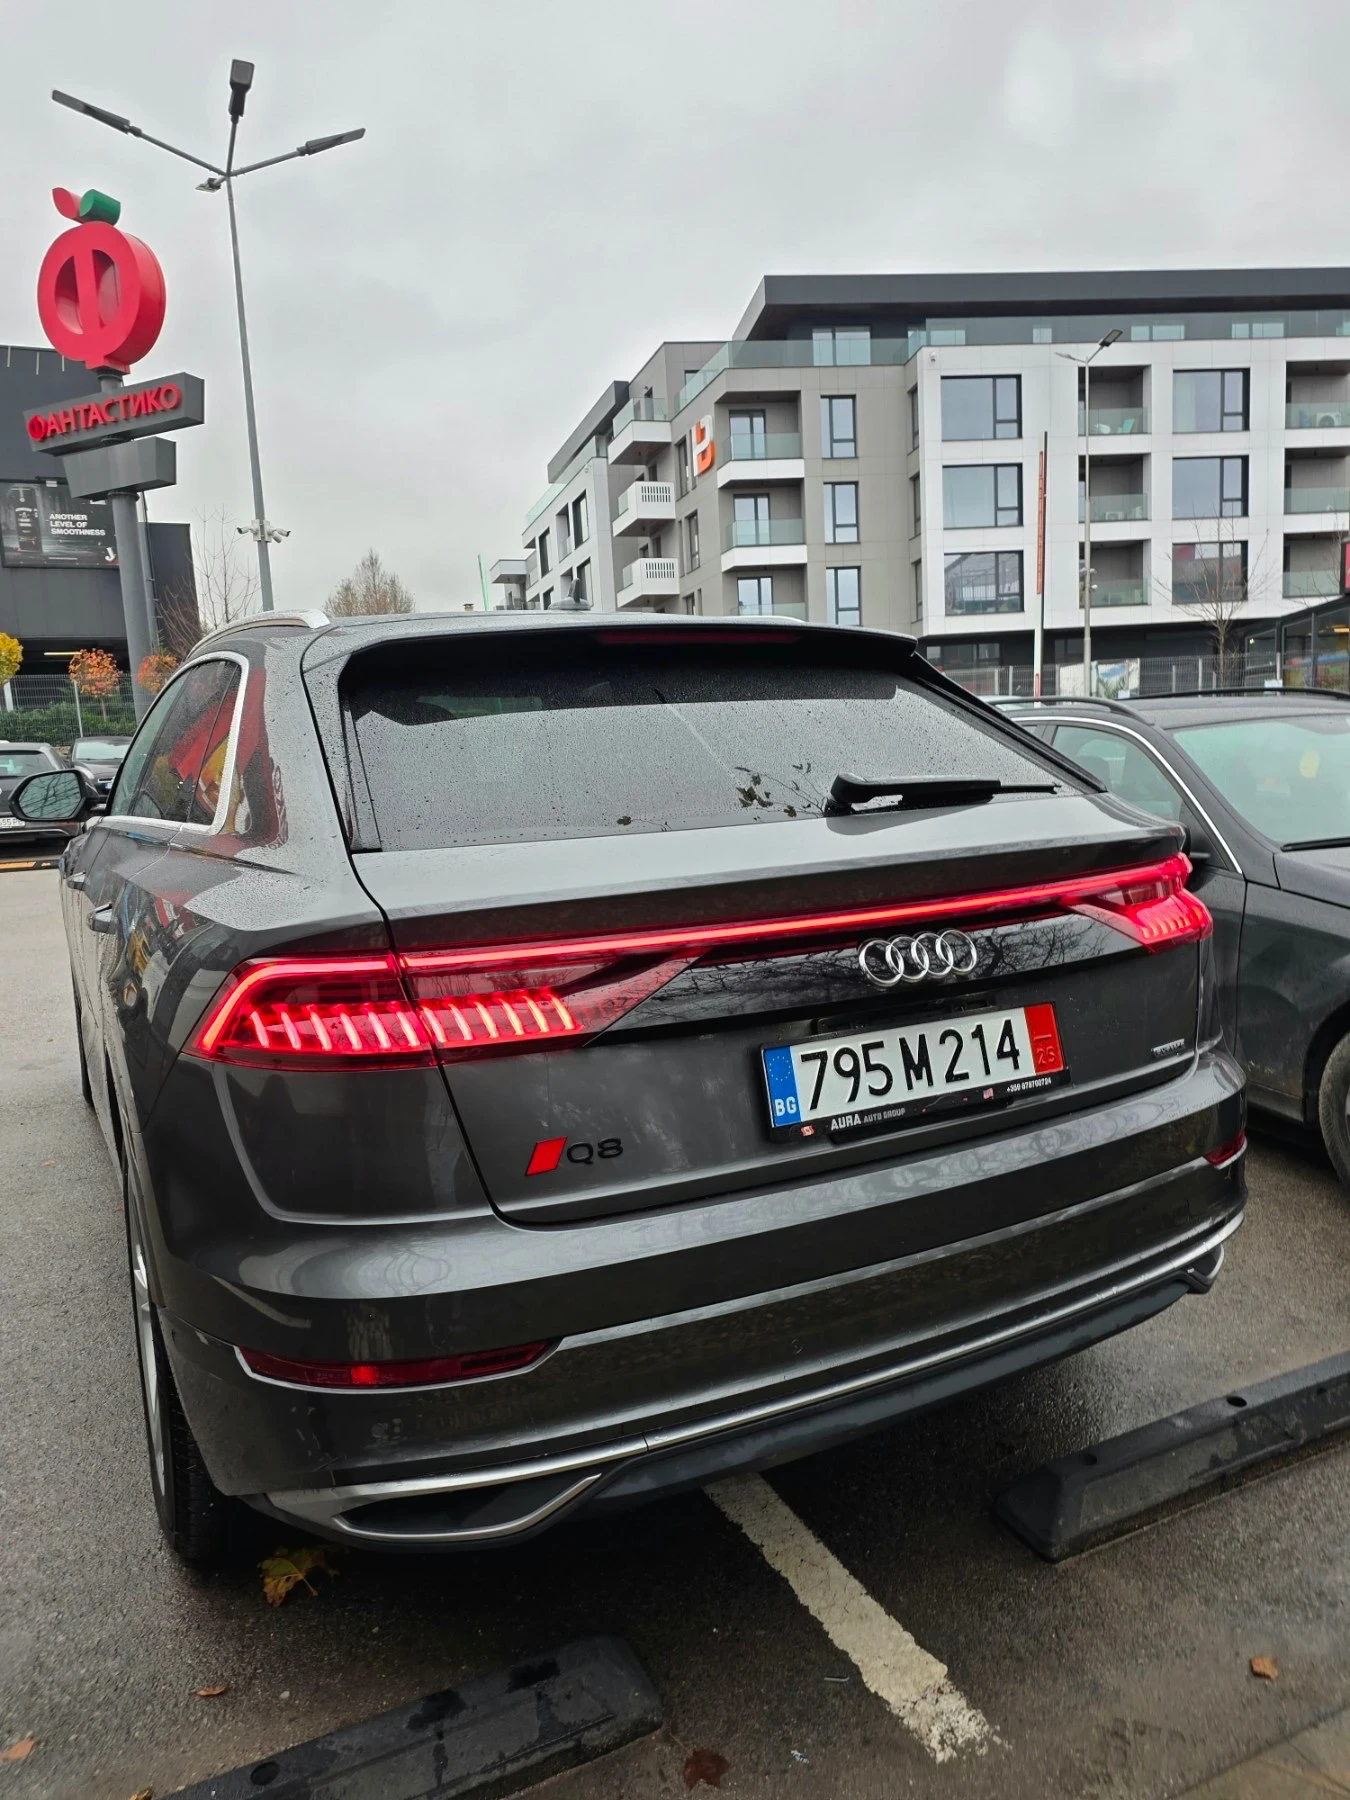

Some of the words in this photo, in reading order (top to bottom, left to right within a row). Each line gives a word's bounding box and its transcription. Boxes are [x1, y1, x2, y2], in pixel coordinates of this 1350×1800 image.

[26, 383, 181, 442] ФАНТАСТИКО
[49, 513, 88, 521] ANOTHER
[50, 520, 75, 528] LEVEL
[51, 528, 106, 536] SMOOTHNESS
[774, 1096, 797, 1117] BG
[830, 1113, 862, 1131] AURA
[863, 1112, 882, 1123] AUTO
[883, 1107, 906, 1119] GROUP
[566, 1137, 624, 1165] Q8
